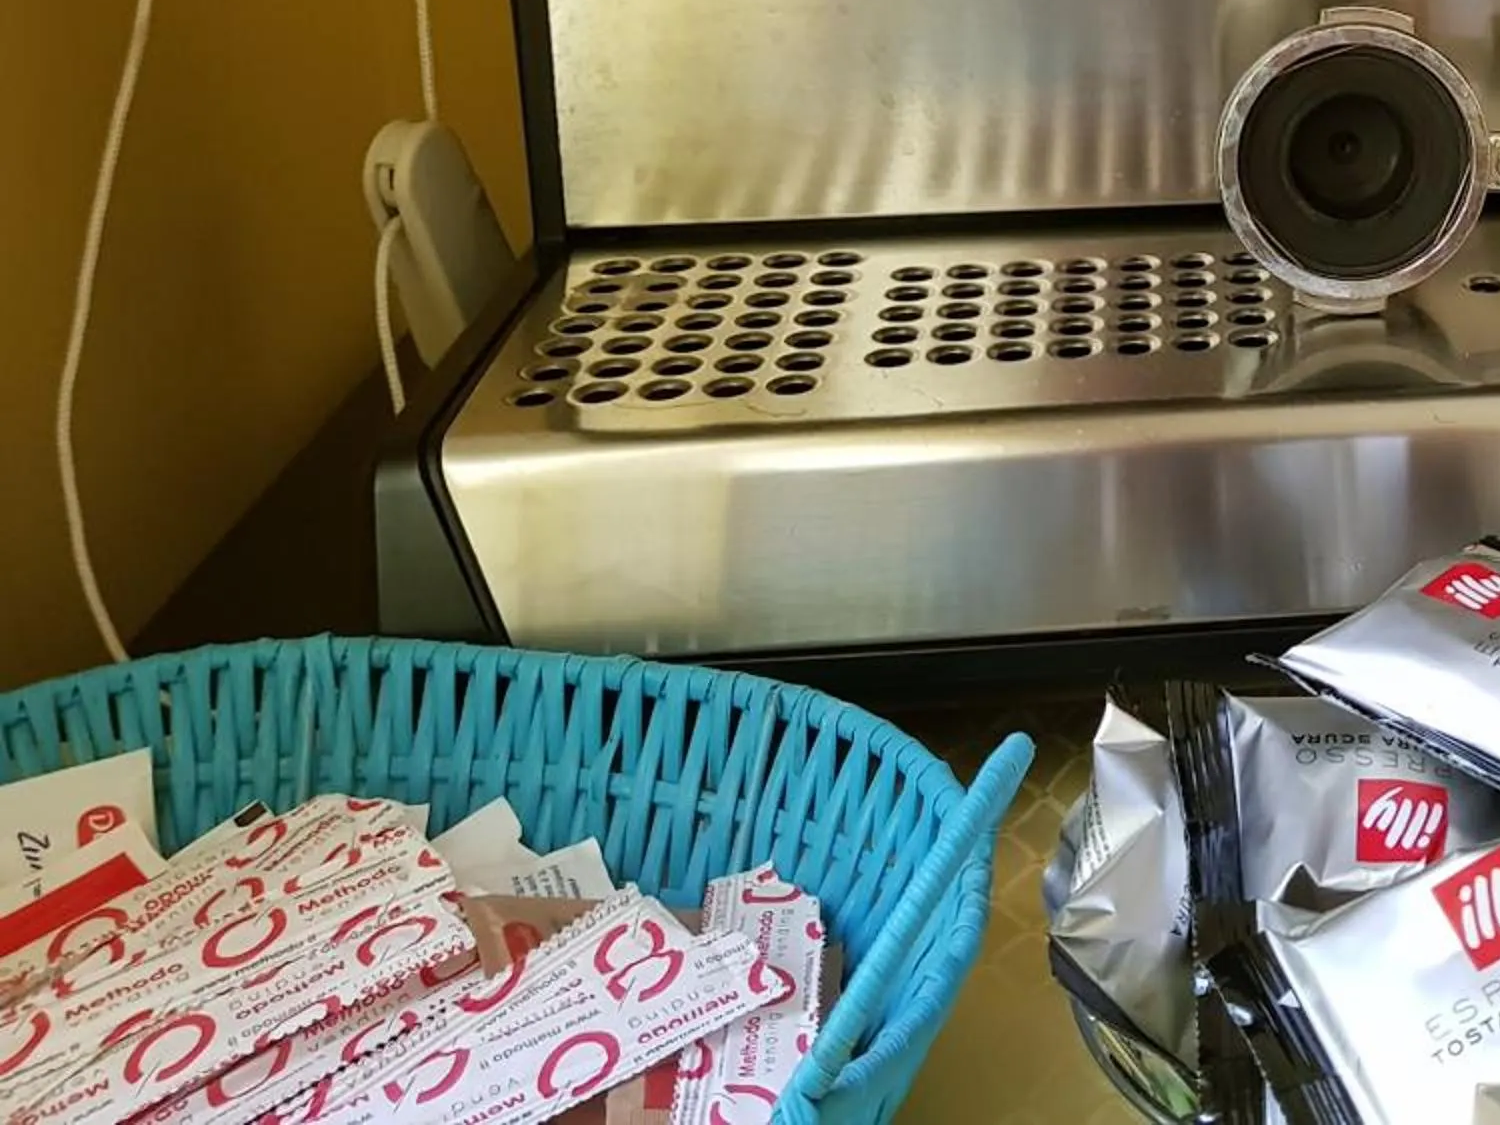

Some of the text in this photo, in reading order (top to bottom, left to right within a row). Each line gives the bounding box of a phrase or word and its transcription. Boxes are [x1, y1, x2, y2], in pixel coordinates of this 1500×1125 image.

[1362, 786, 1444, 850] illy
[64, 962, 184, 1021] Methodo
[235, 959, 346, 1021] Methodo
